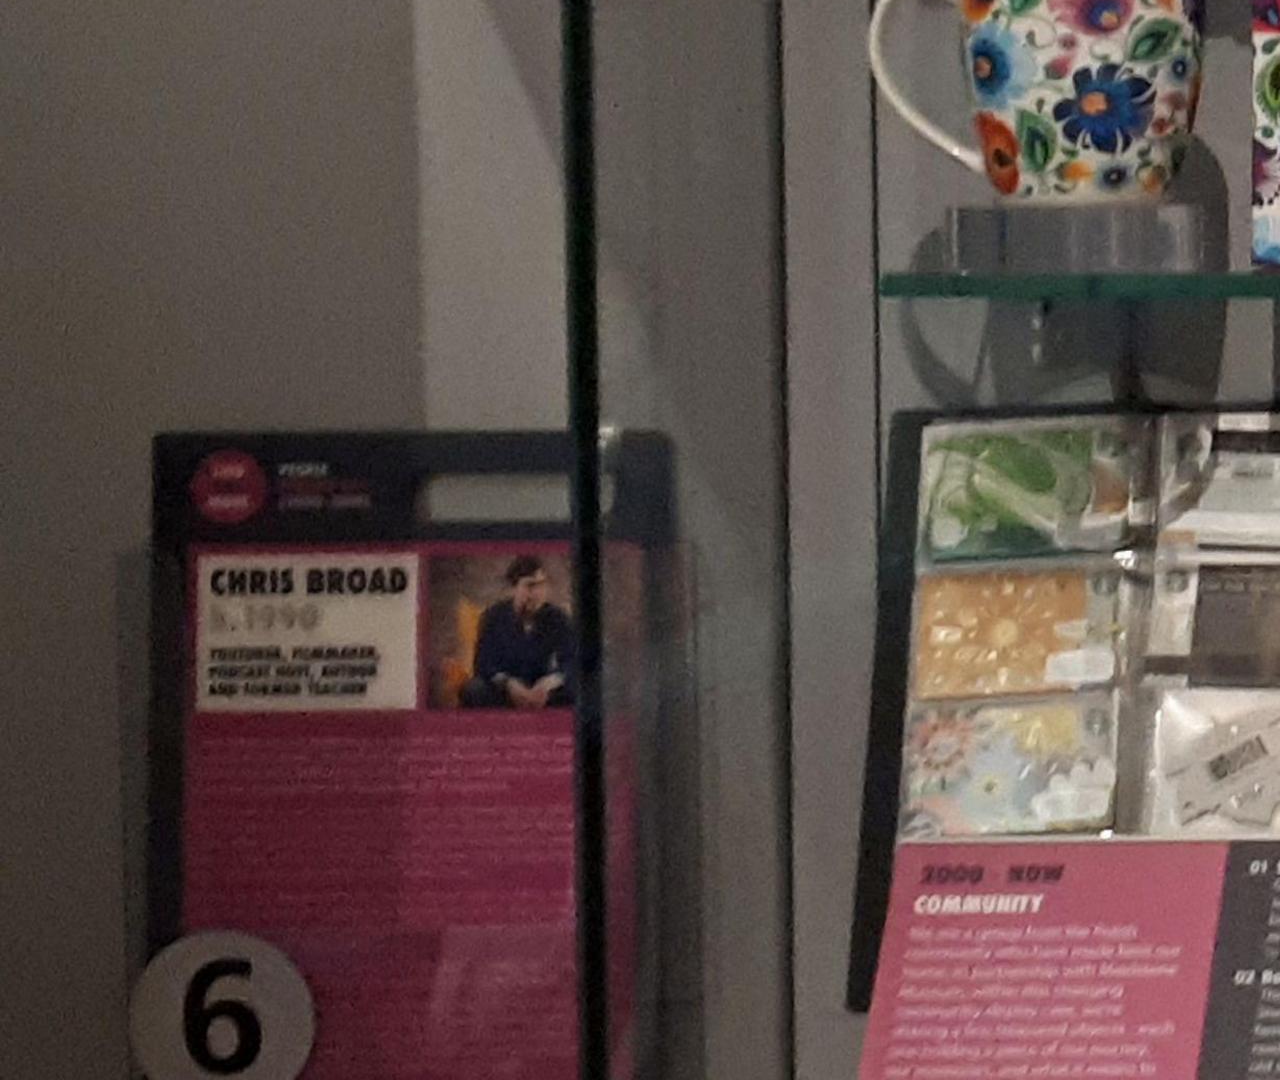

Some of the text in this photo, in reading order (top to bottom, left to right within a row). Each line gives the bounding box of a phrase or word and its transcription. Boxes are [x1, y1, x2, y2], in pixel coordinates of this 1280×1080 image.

[210, 566, 408, 596] CHRIS BROAD
[914, 893, 1044, 913] COMMUNITY
[183, 958, 263, 1075] 6
